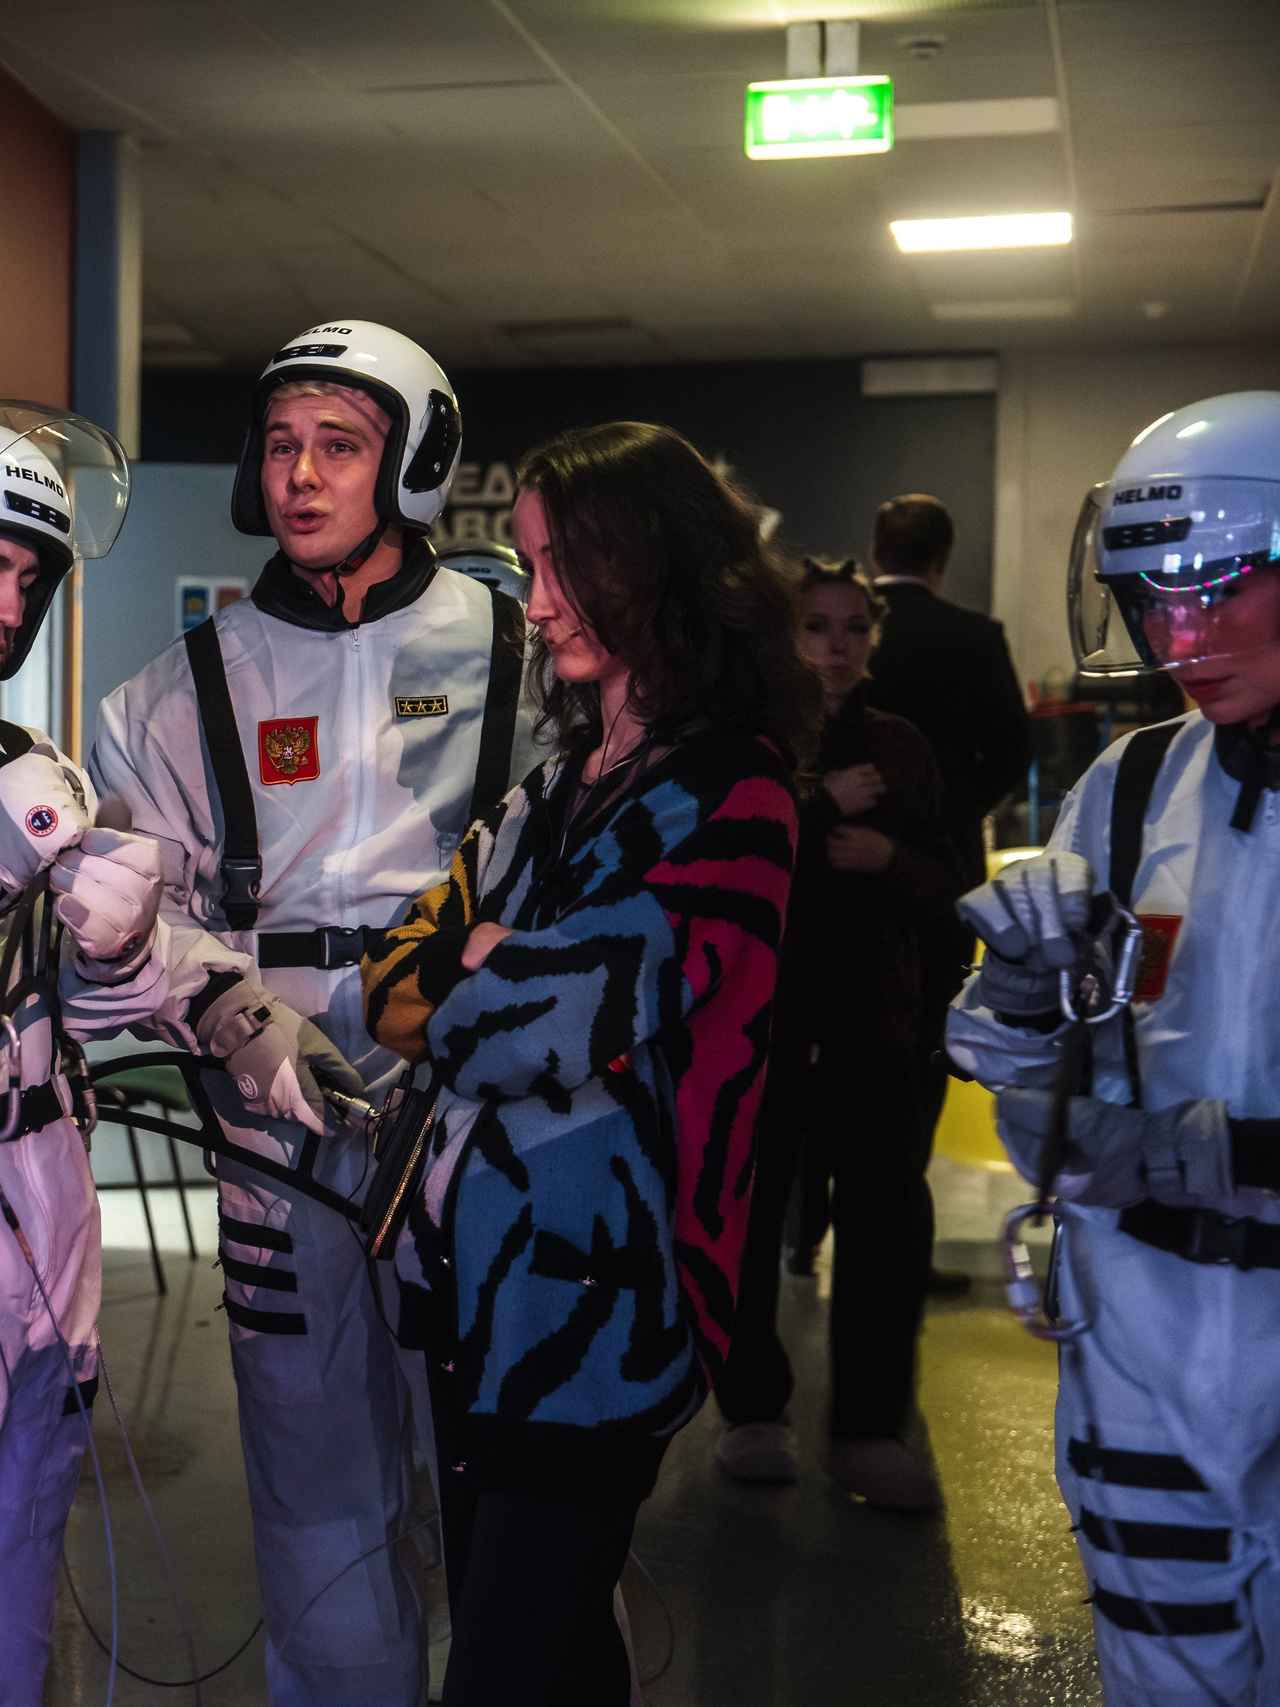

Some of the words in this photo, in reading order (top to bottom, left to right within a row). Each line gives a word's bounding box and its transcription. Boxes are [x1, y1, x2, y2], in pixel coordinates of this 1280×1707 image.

[296, 327, 352, 339] ELMO
[5, 465, 64, 498] HELMO
[1113, 485, 1183, 506] HELMO
